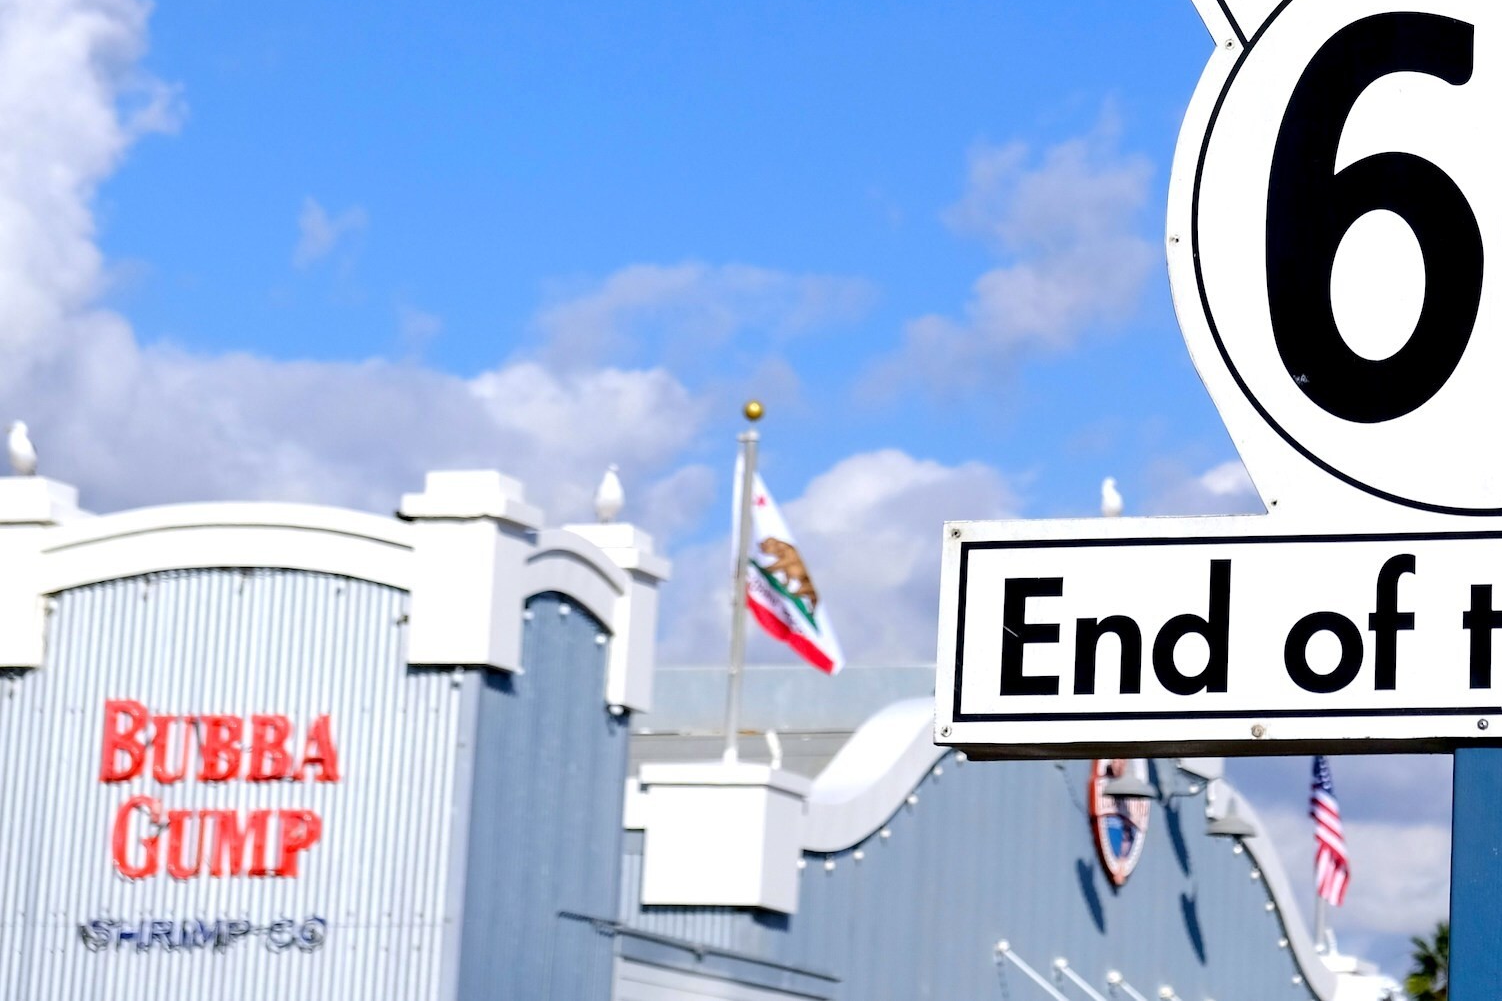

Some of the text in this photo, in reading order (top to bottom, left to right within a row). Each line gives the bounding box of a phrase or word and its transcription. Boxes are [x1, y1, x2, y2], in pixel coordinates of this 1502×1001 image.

[999, 558, 1232, 697] End
[1283, 553, 1416, 694] of
[99, 698, 340, 784] BUBBA
[111, 794, 322, 880] GUMP
[79, 916, 250, 954] SHRIMP
